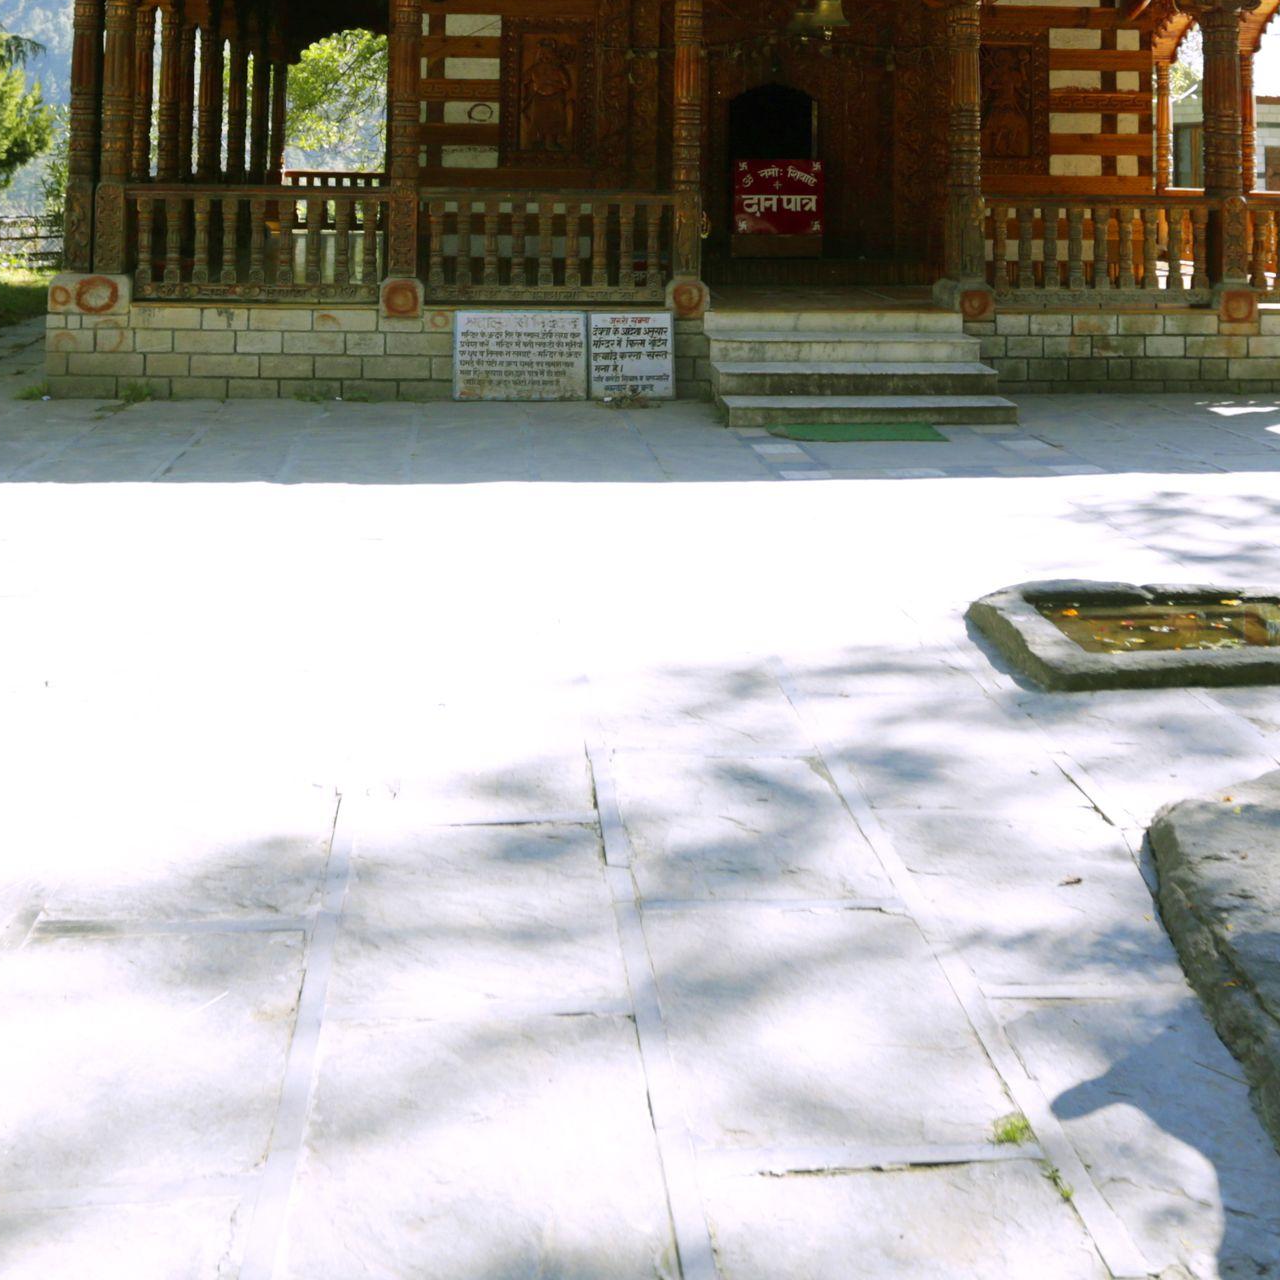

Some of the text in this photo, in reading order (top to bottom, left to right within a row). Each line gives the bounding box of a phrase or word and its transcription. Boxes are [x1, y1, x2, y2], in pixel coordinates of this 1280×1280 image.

[741, 194, 817, 217] दान पात्र
[593, 337, 615, 348] मन्दिर
[594, 364, 610, 373] मना
